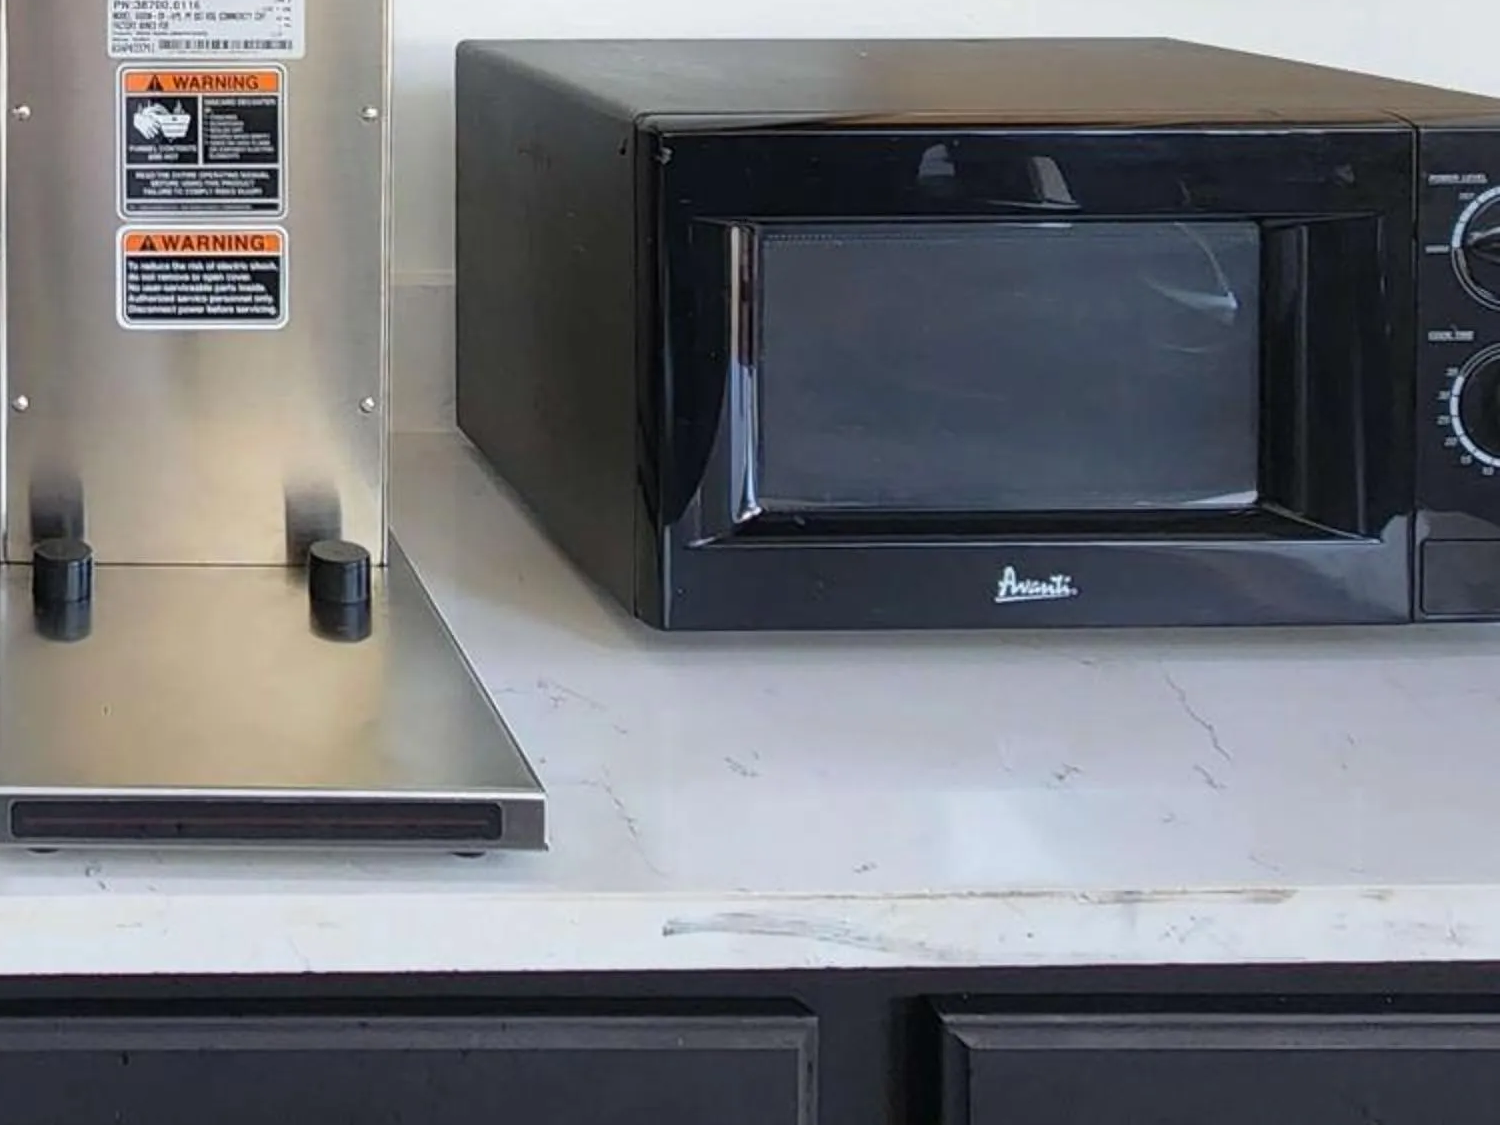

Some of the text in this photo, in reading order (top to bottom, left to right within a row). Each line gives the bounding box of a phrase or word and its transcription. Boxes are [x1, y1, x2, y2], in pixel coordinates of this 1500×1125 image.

[173, 76, 260, 90] WARNING
[161, 235, 265, 251] WARNING
[996, 565, 1074, 599] Avanti
